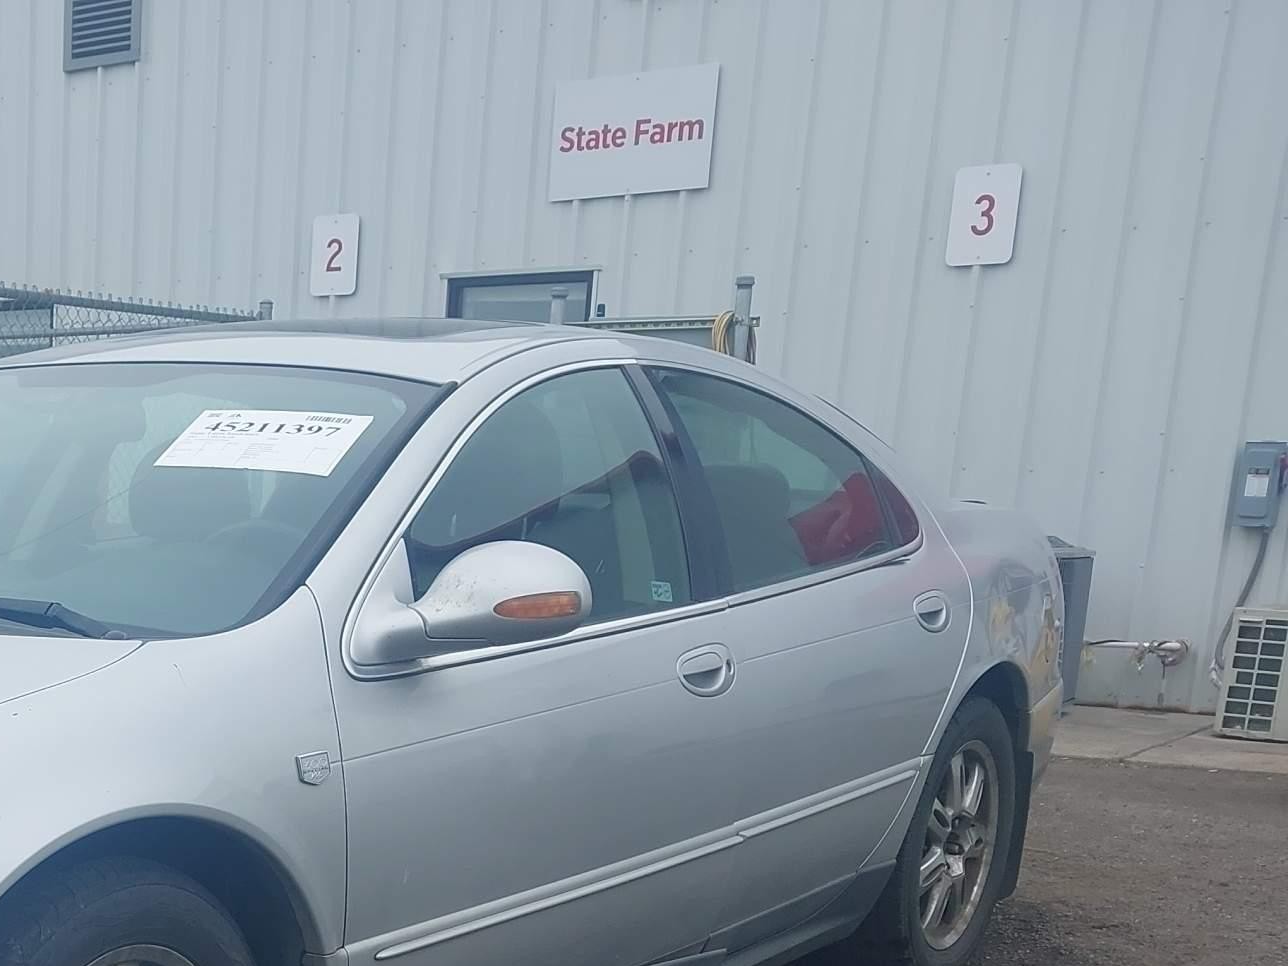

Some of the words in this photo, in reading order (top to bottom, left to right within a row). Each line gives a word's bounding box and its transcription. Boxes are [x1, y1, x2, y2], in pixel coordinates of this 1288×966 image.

[559, 123, 627, 153] State
[633, 117, 705, 146] Farm
[970, 193, 996, 236] 3
[325, 238, 343, 273] 2
[203, 420, 343, 438] 45211397
